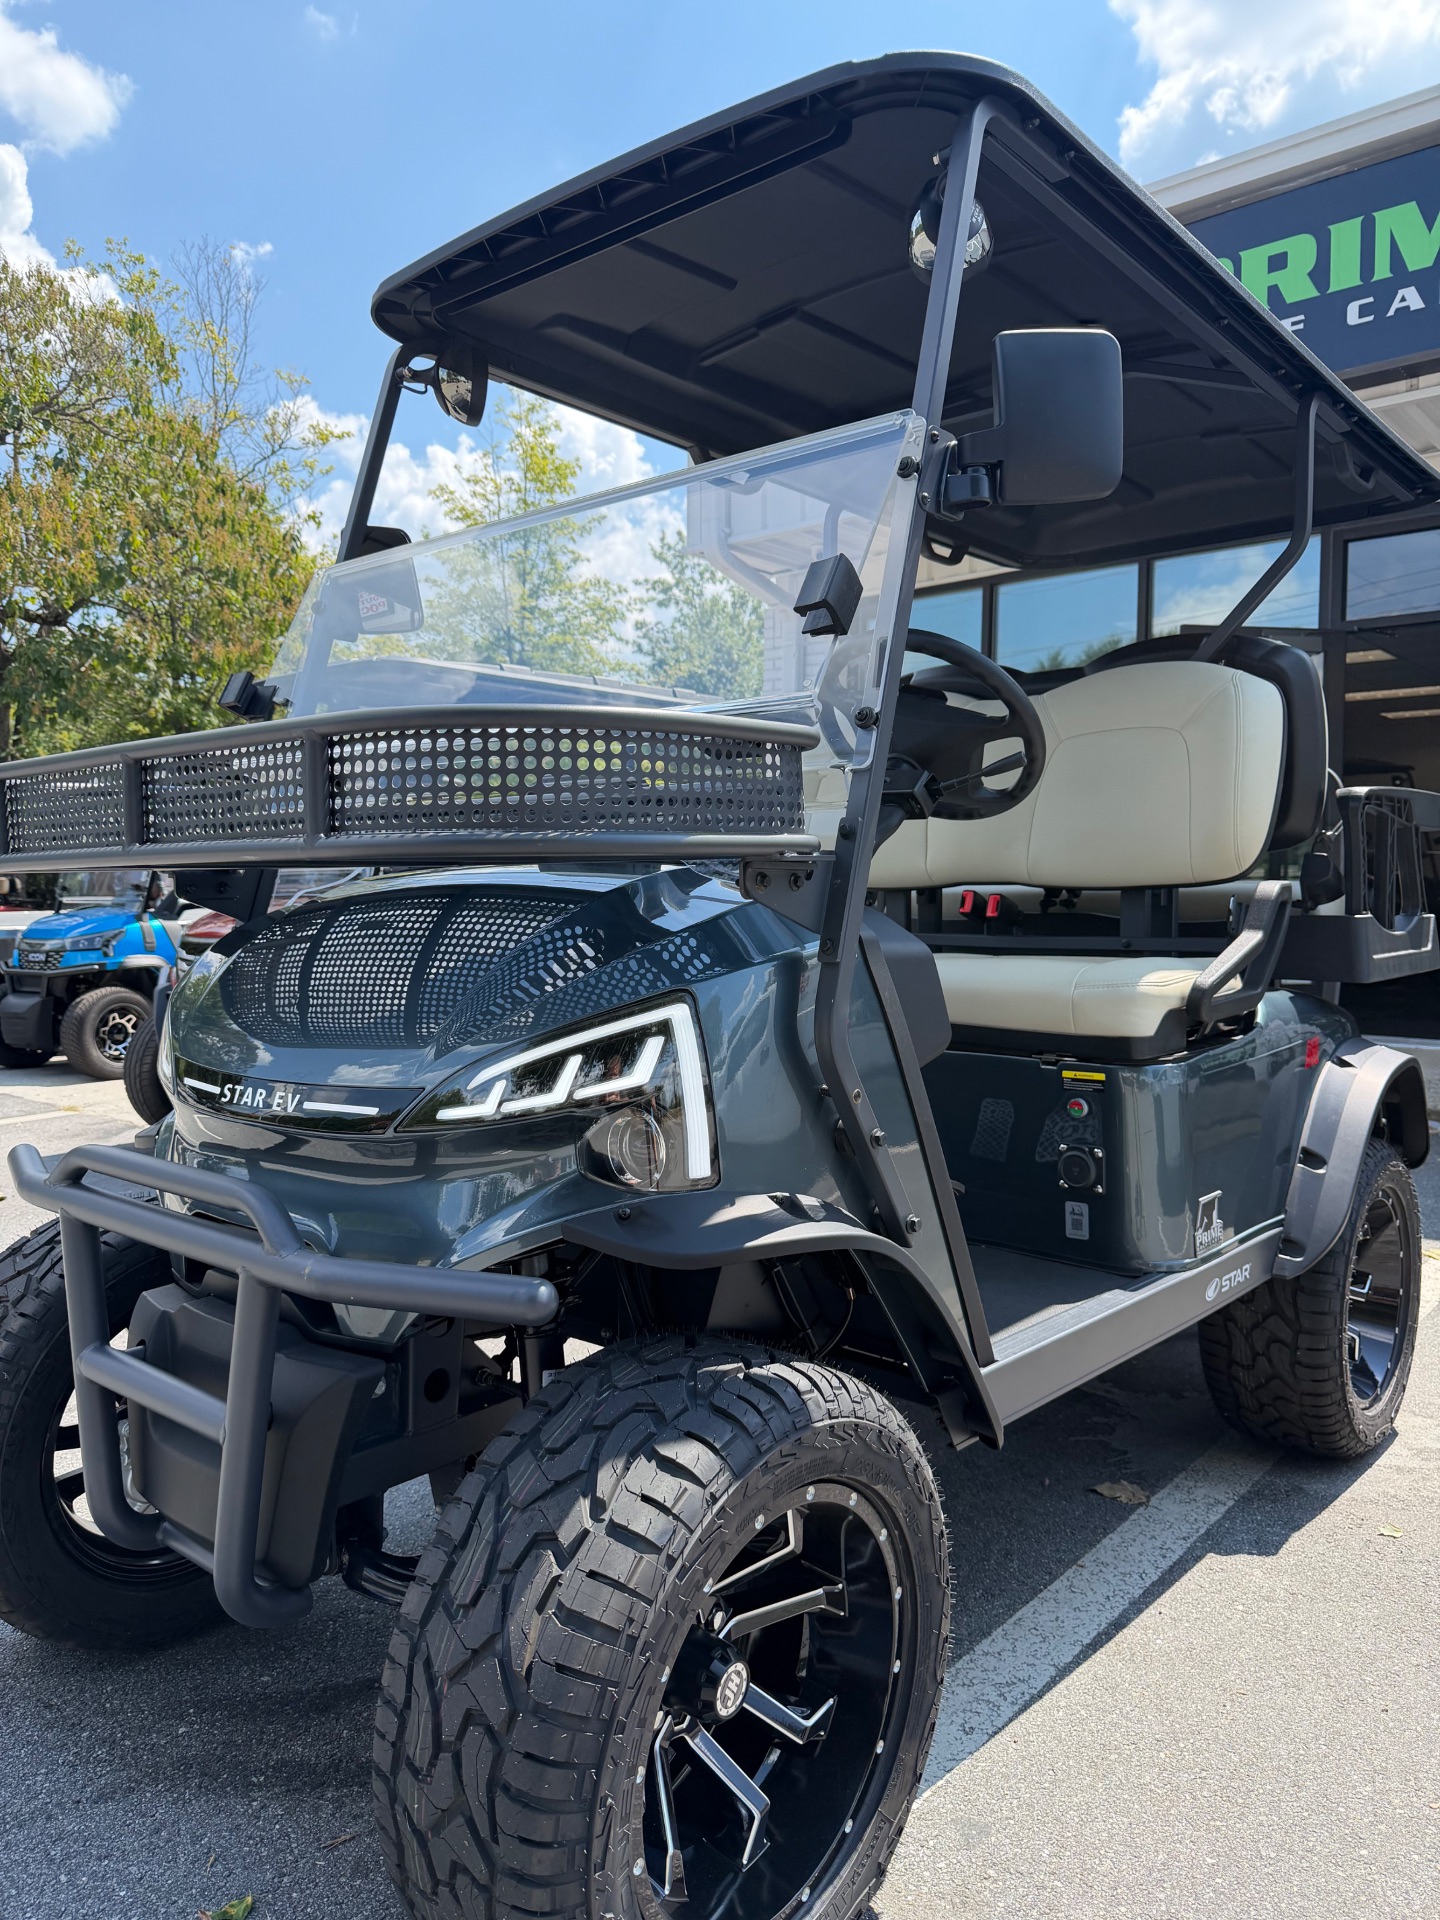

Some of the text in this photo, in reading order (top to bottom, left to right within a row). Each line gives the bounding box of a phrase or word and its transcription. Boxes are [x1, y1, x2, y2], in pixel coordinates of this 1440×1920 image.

[1217, 200, 1440, 309] RIM
[1346, 285, 1440, 326] CA
[221, 1083, 301, 1113] STAR EV
[1221, 1263, 1251, 1292] STAR
